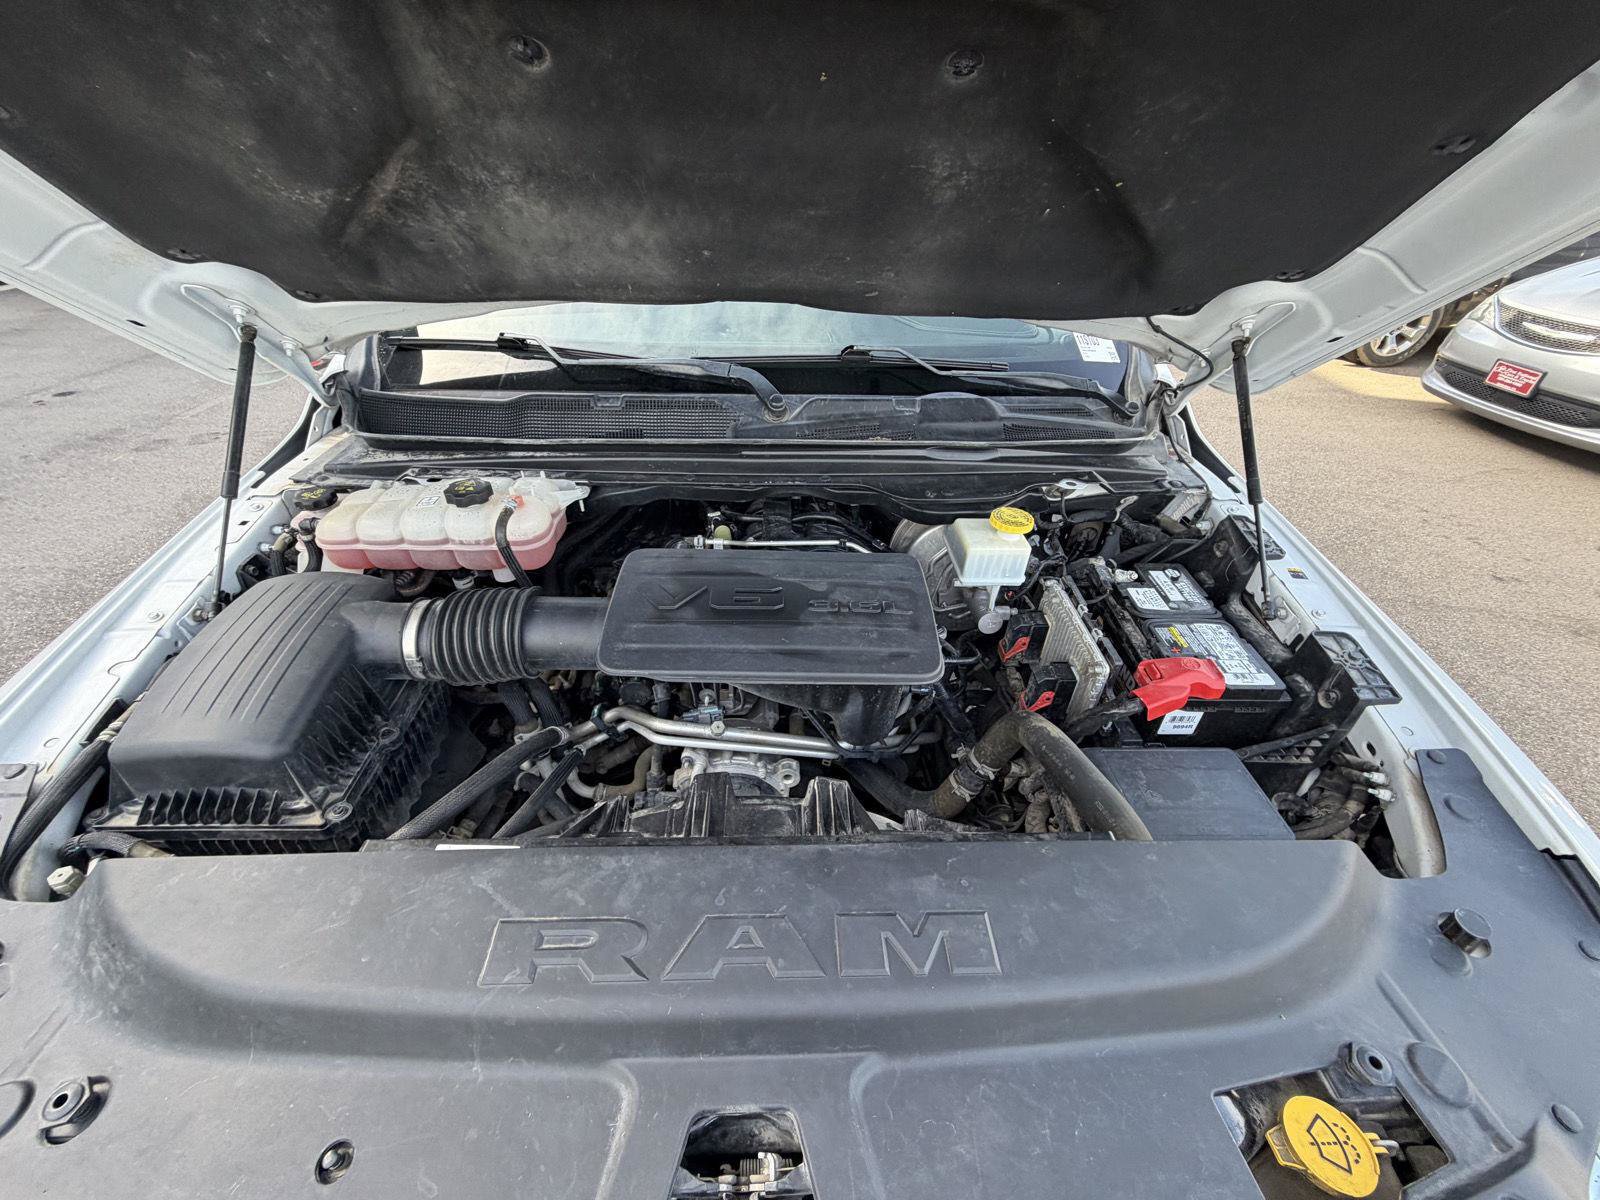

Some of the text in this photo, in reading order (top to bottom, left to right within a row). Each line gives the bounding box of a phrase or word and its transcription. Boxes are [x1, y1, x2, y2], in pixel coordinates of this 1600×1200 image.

[637, 584, 913, 615] V6 3.6L
[477, 910, 1003, 986] RAM
